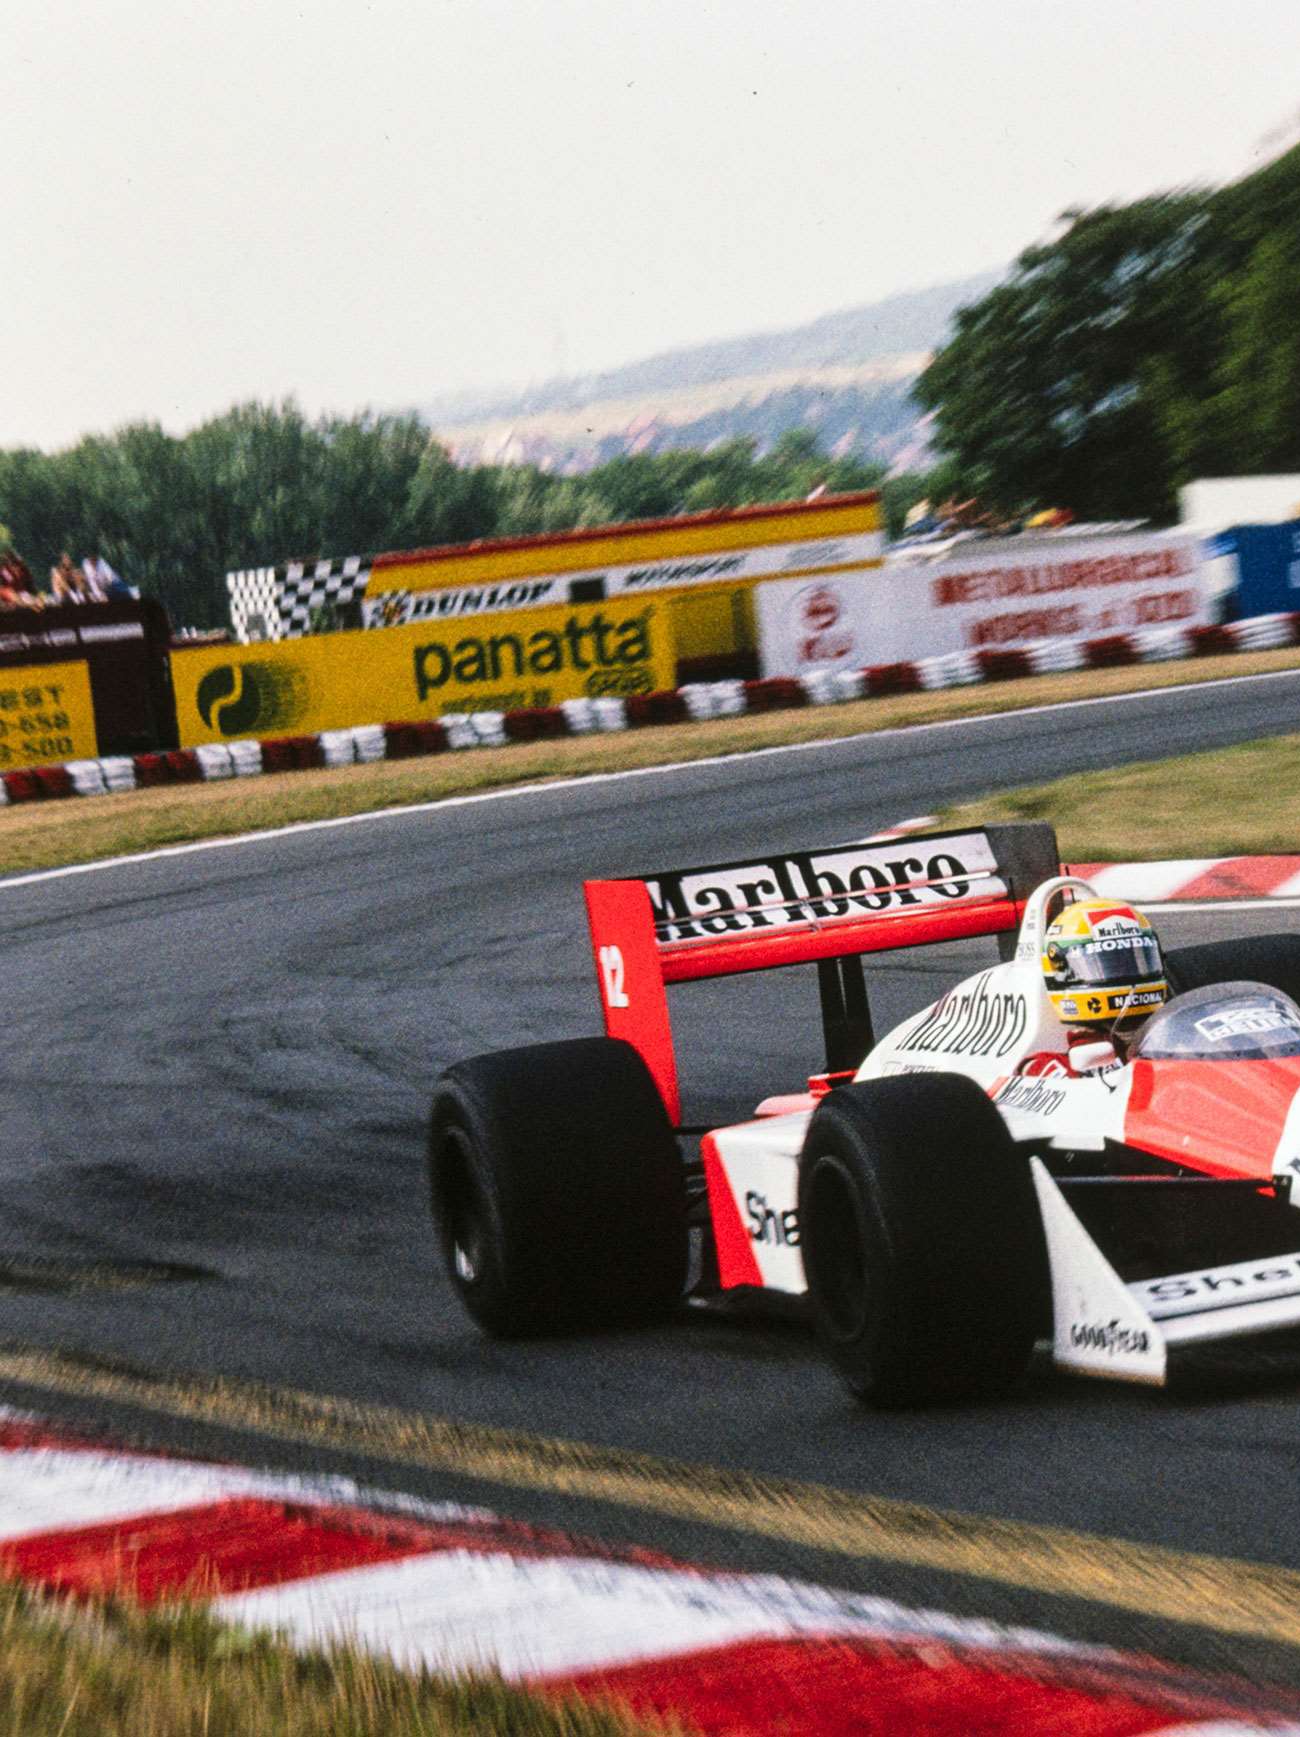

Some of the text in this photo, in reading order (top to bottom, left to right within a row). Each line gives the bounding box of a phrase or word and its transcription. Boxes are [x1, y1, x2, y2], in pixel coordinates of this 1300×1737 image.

[411, 579, 553, 614] DUNLOP
[413, 605, 655, 701] panatta
[647, 851, 971, 942] Marlboro
[1086, 936, 1153, 954] HONDA
[1098, 921, 1141, 937] Marlboro
[599, 945, 630, 1008] 12
[895, 970, 1027, 1058] Marlboro
[997, 1075, 1067, 1116] Marlboro
[746, 1190, 801, 1246] She
